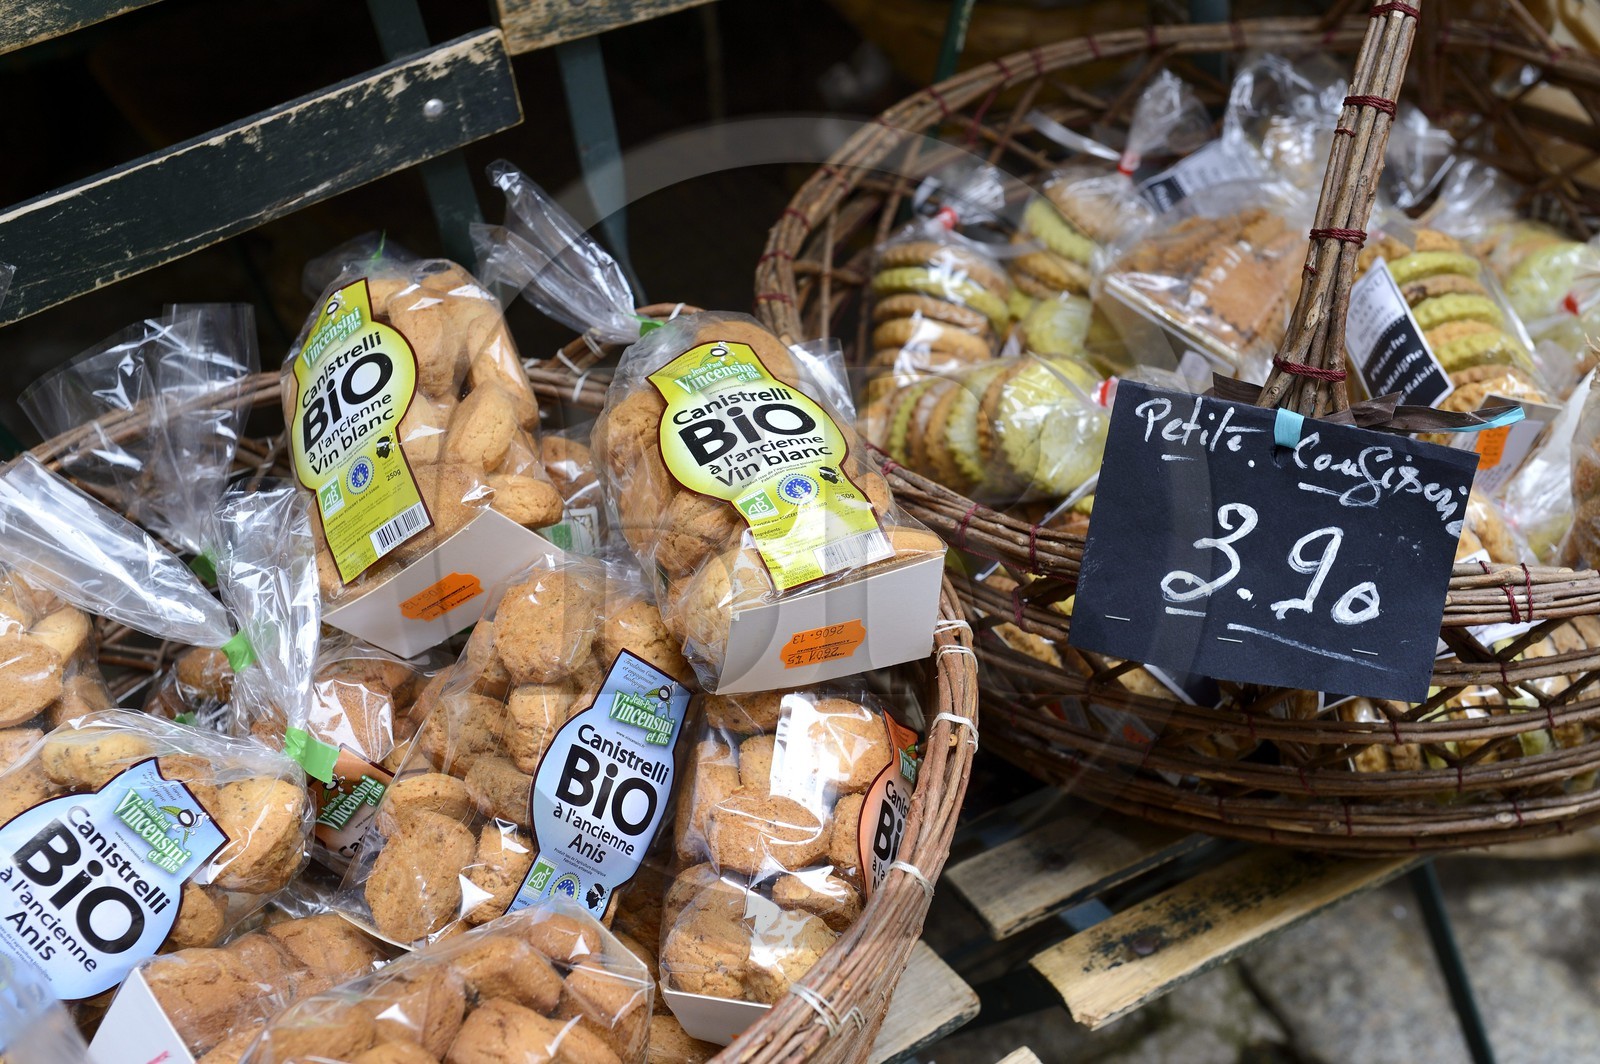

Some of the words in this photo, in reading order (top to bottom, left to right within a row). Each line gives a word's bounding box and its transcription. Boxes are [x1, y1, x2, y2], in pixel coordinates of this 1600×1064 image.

[303, 307, 361, 368] Vincensini
[302, 332, 381, 408] Canistrelli
[674, 361, 757, 395] Vincensini
[690, 361, 723, 375] Jean-Paul
[737, 374, 748, 382] et
[302, 353, 393, 453] BiO
[673, 388, 793, 425] Canistrelli
[309, 450, 317, 463] à
[317, 394, 392, 455] l'ancienne
[311, 449, 339, 476] Vin
[341, 408, 394, 452] blanc
[678, 403, 816, 466] BiO
[386, 469, 402, 481] 250g
[709, 464, 722, 475] à
[723, 435, 825, 467] l'ancienne
[715, 464, 760, 487] Vin
[762, 446, 833, 467] blanc
[324, 489, 339, 511] AB
[748, 500, 770, 515] AB
[1161, 502, 1381, 625] 3.90
[610, 691, 675, 734] Vincensini
[630, 693, 657, 713] Jean-Paul
[578, 724, 670, 785] Canistrelli
[646, 731, 656, 742] et
[656, 732, 670, 744] fils
[317, 775, 375, 830] Vincensini
[366, 796, 376, 806] et
[369, 784, 382, 799] fils
[555, 744, 657, 836] BiO
[114, 788, 191, 865] Vincensini
[142, 800, 172, 830] Jean-Paul
[553, 802, 563, 818] à
[565, 808, 634, 856] l'ancienne
[873, 799, 903, 864] Bi
[67, 806, 171, 915] Canistrelli
[148, 850, 161, 862] et
[160, 853, 179, 872] fils
[568, 834, 606, 863] Anis
[10, 817, 145, 954] BiO
[528, 871, 546, 889] AB
[0, 866, 13, 883] à
[11, 879, 97, 973] l'ancienne
[5, 911, 56, 961] Anis
